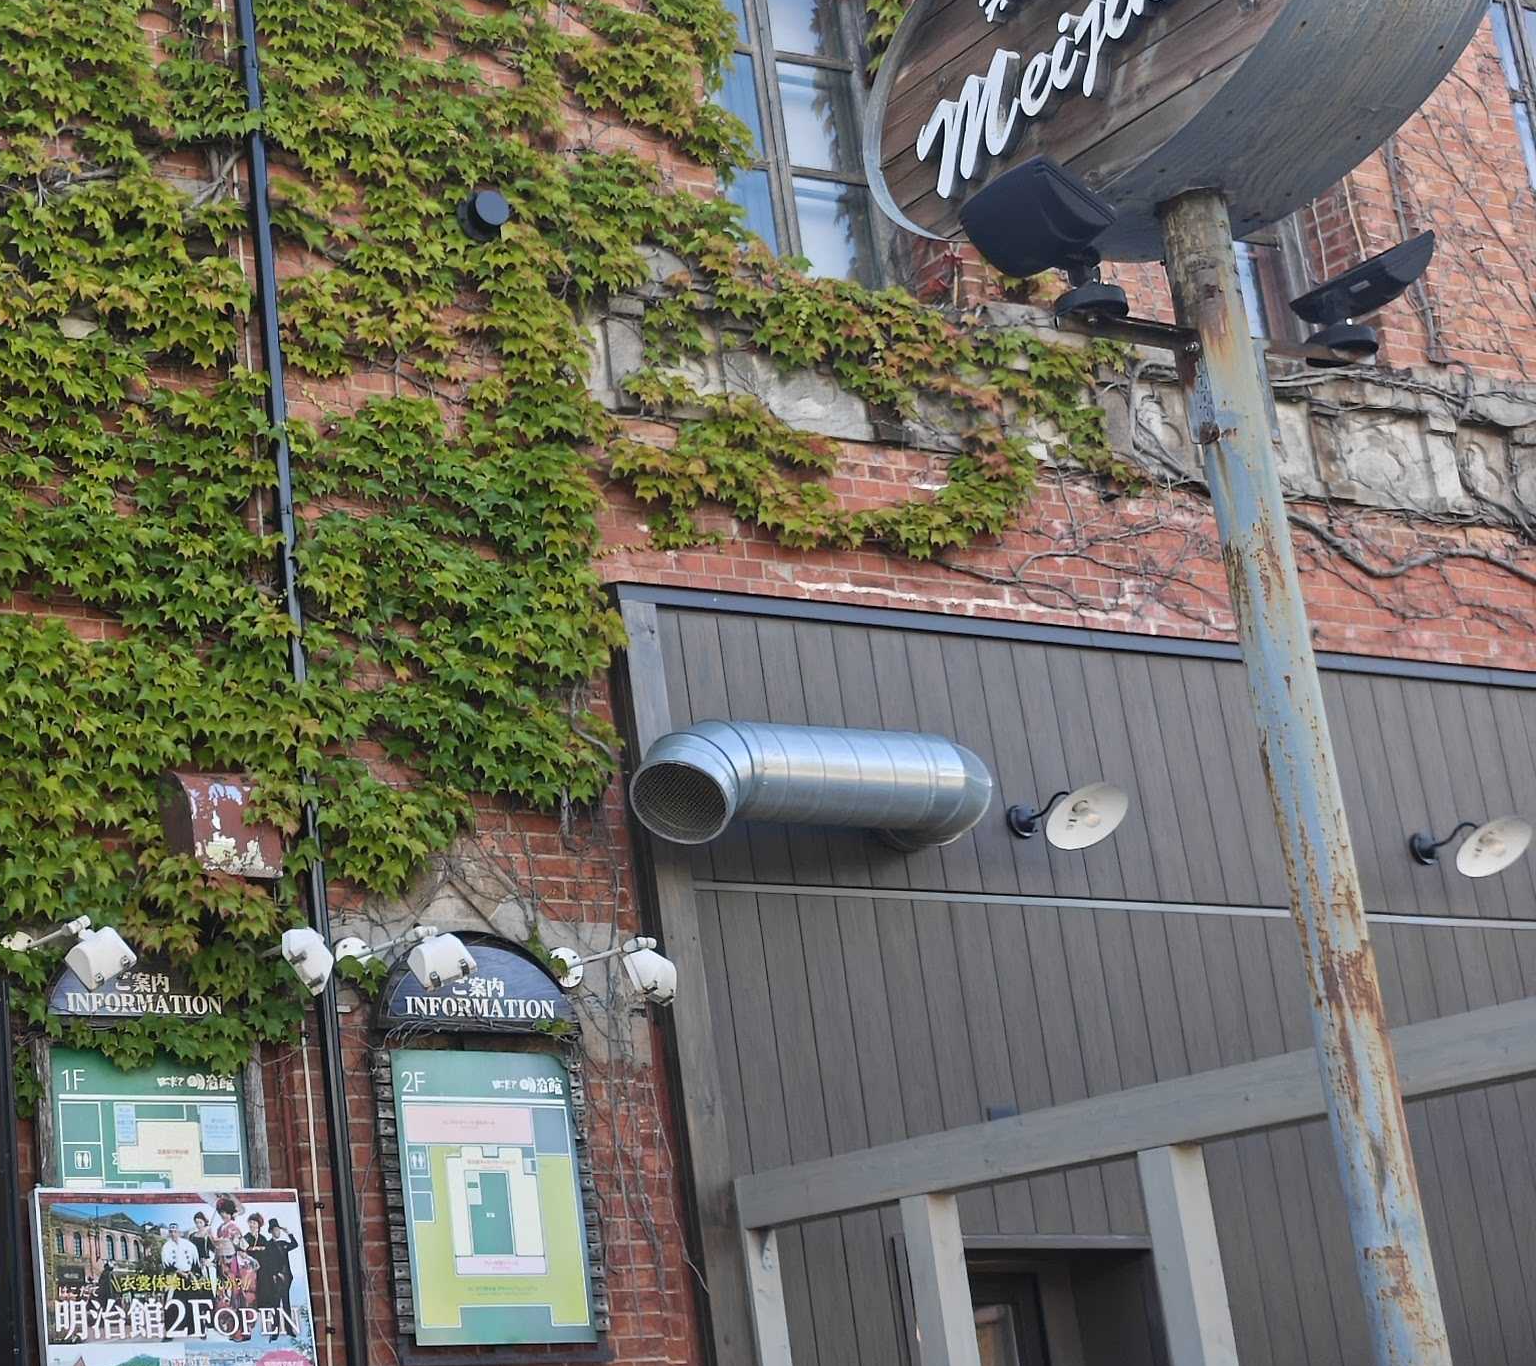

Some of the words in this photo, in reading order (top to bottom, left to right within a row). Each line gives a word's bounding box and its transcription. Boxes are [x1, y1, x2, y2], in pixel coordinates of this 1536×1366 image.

[115, 972, 170, 993] ご案内
[452, 977, 505, 998] ご案内
[66, 992, 223, 1016] INFORMATION
[405, 996, 556, 1019] INFORMATION
[62, 1068, 86, 1091] 1F
[401, 1071, 426, 1093] 2F
[58, 1285, 99, 1297] はこだて
